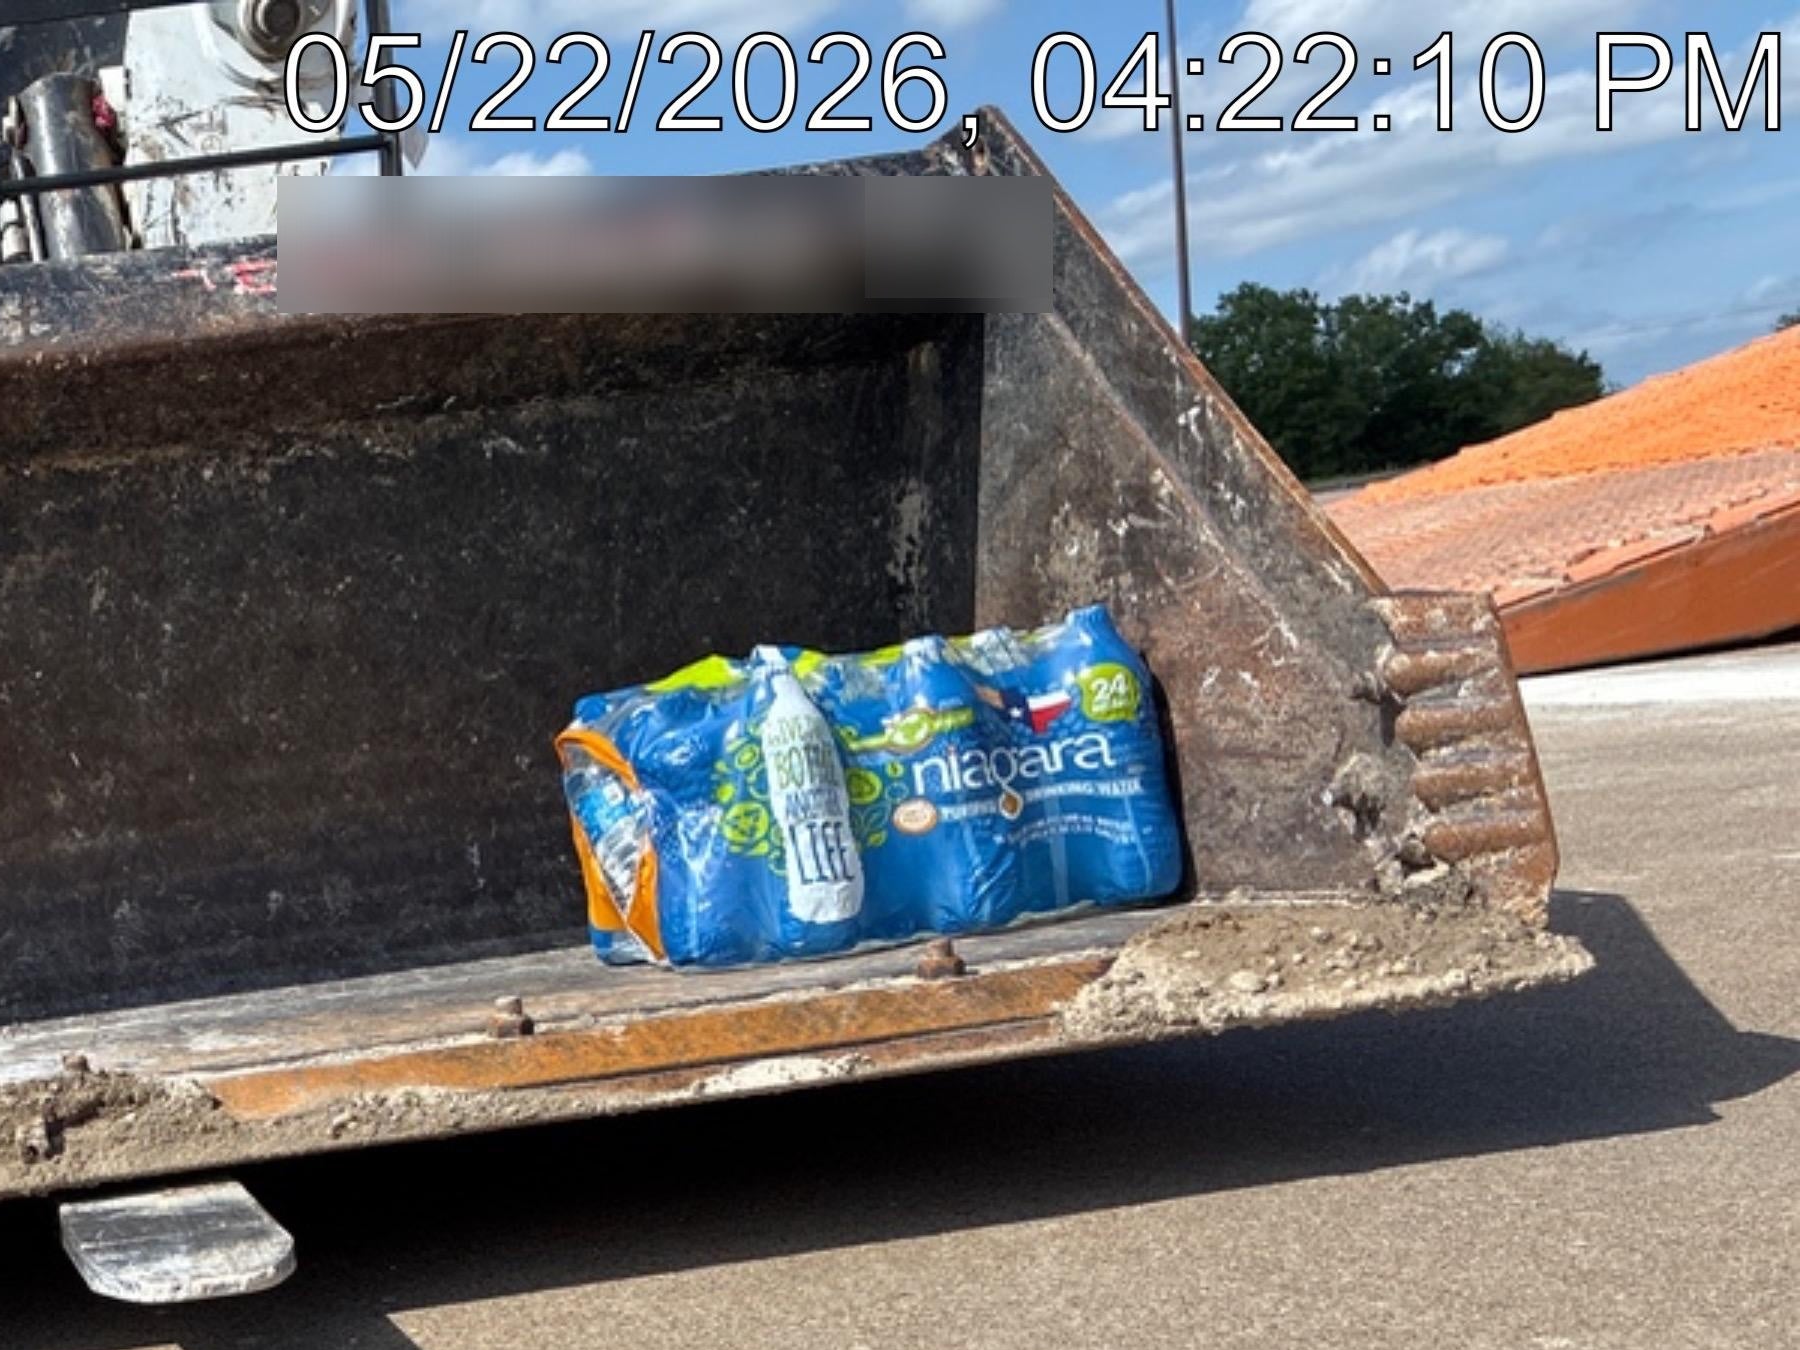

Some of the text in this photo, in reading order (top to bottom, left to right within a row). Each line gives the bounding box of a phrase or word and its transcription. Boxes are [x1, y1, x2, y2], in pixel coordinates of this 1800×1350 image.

[1091, 671, 1129, 702] 24
[911, 732, 1117, 796] niagara
[789, 821, 855, 884] LIFE
